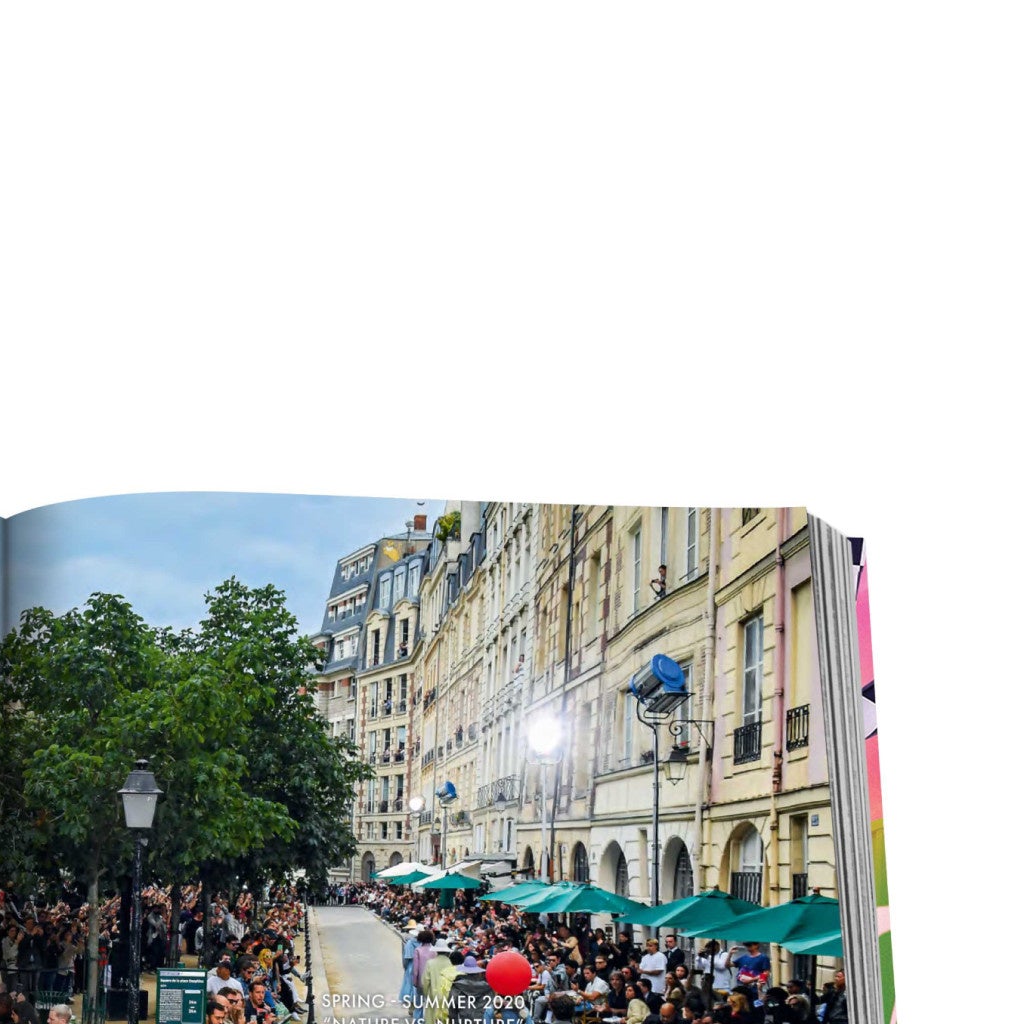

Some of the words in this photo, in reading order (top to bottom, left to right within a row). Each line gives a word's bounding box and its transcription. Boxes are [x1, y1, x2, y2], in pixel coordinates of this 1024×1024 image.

[322, 994, 385, 1009] SPRING
[402, 994, 476, 1009] SUMMER
[482, 994, 525, 1009] 2020
